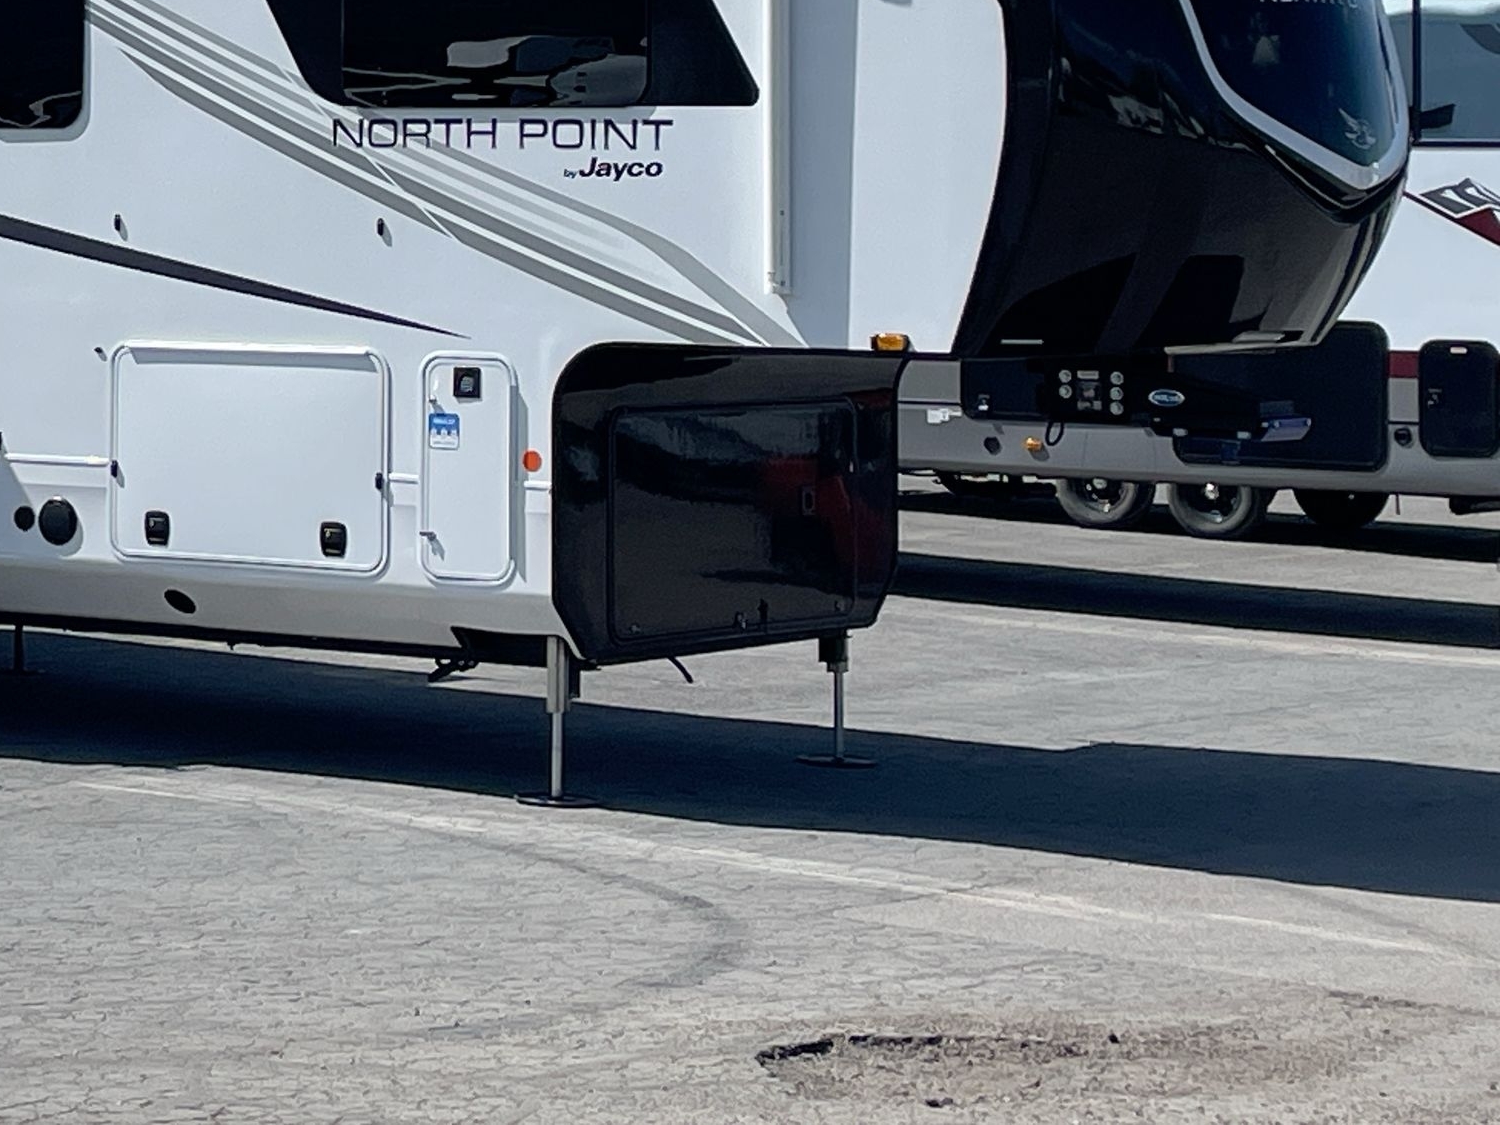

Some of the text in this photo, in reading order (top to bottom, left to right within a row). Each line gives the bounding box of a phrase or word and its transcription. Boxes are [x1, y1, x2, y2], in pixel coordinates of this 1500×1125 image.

[332, 118, 674, 151] NORTH POINT
[579, 156, 664, 182] Jayco
